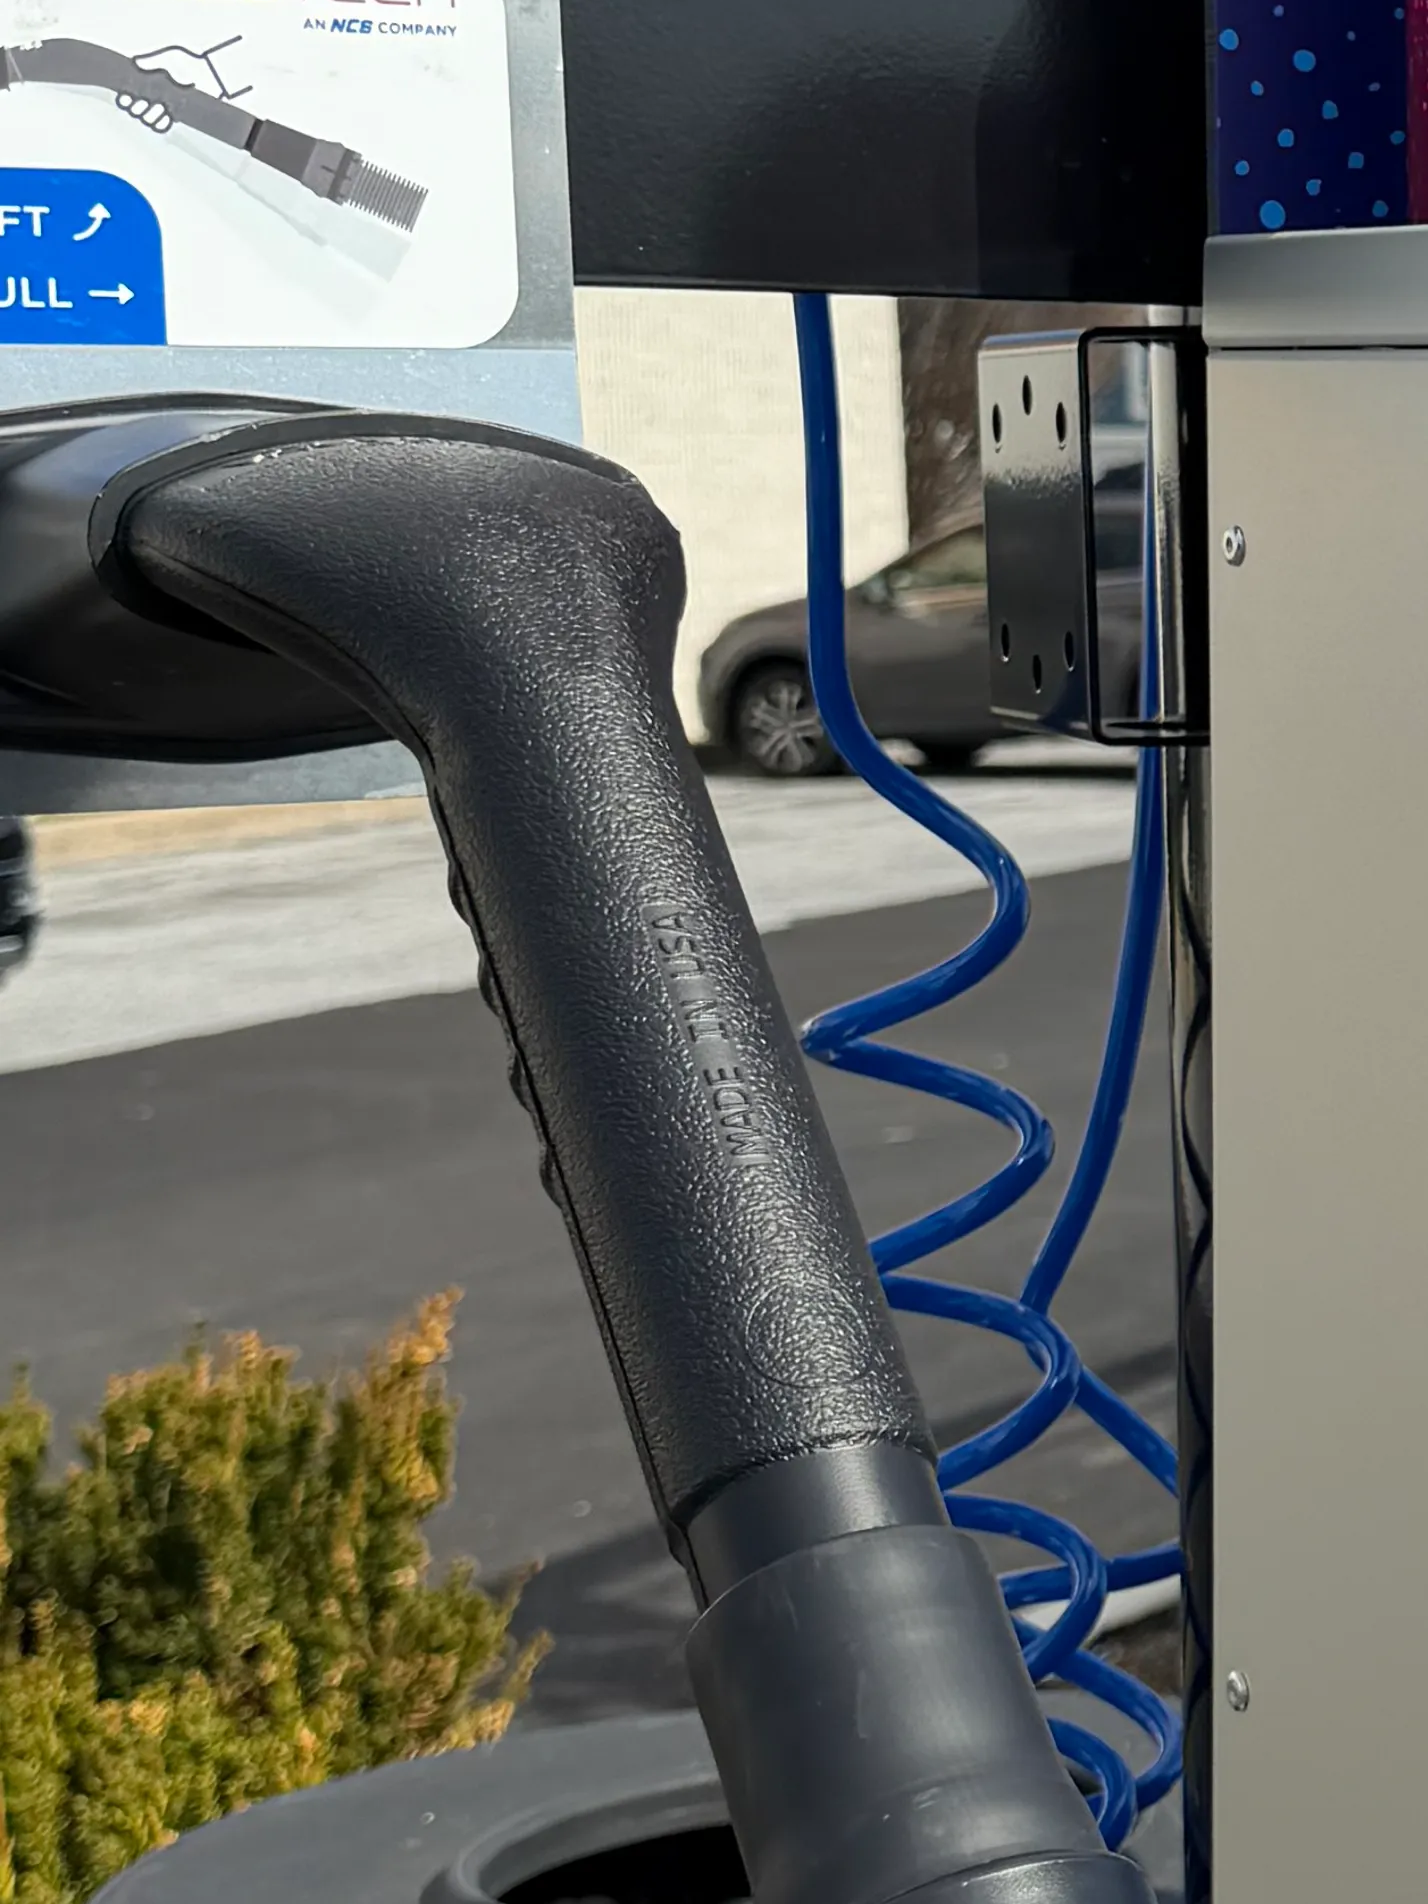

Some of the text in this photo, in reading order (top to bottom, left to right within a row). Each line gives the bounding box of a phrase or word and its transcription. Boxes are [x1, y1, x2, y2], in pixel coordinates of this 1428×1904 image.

[303, 18, 326, 30] AN
[378, 21, 457, 37] COMPANY
[0, 205, 50, 237] FT
[0, 276, 73, 308] ULL
